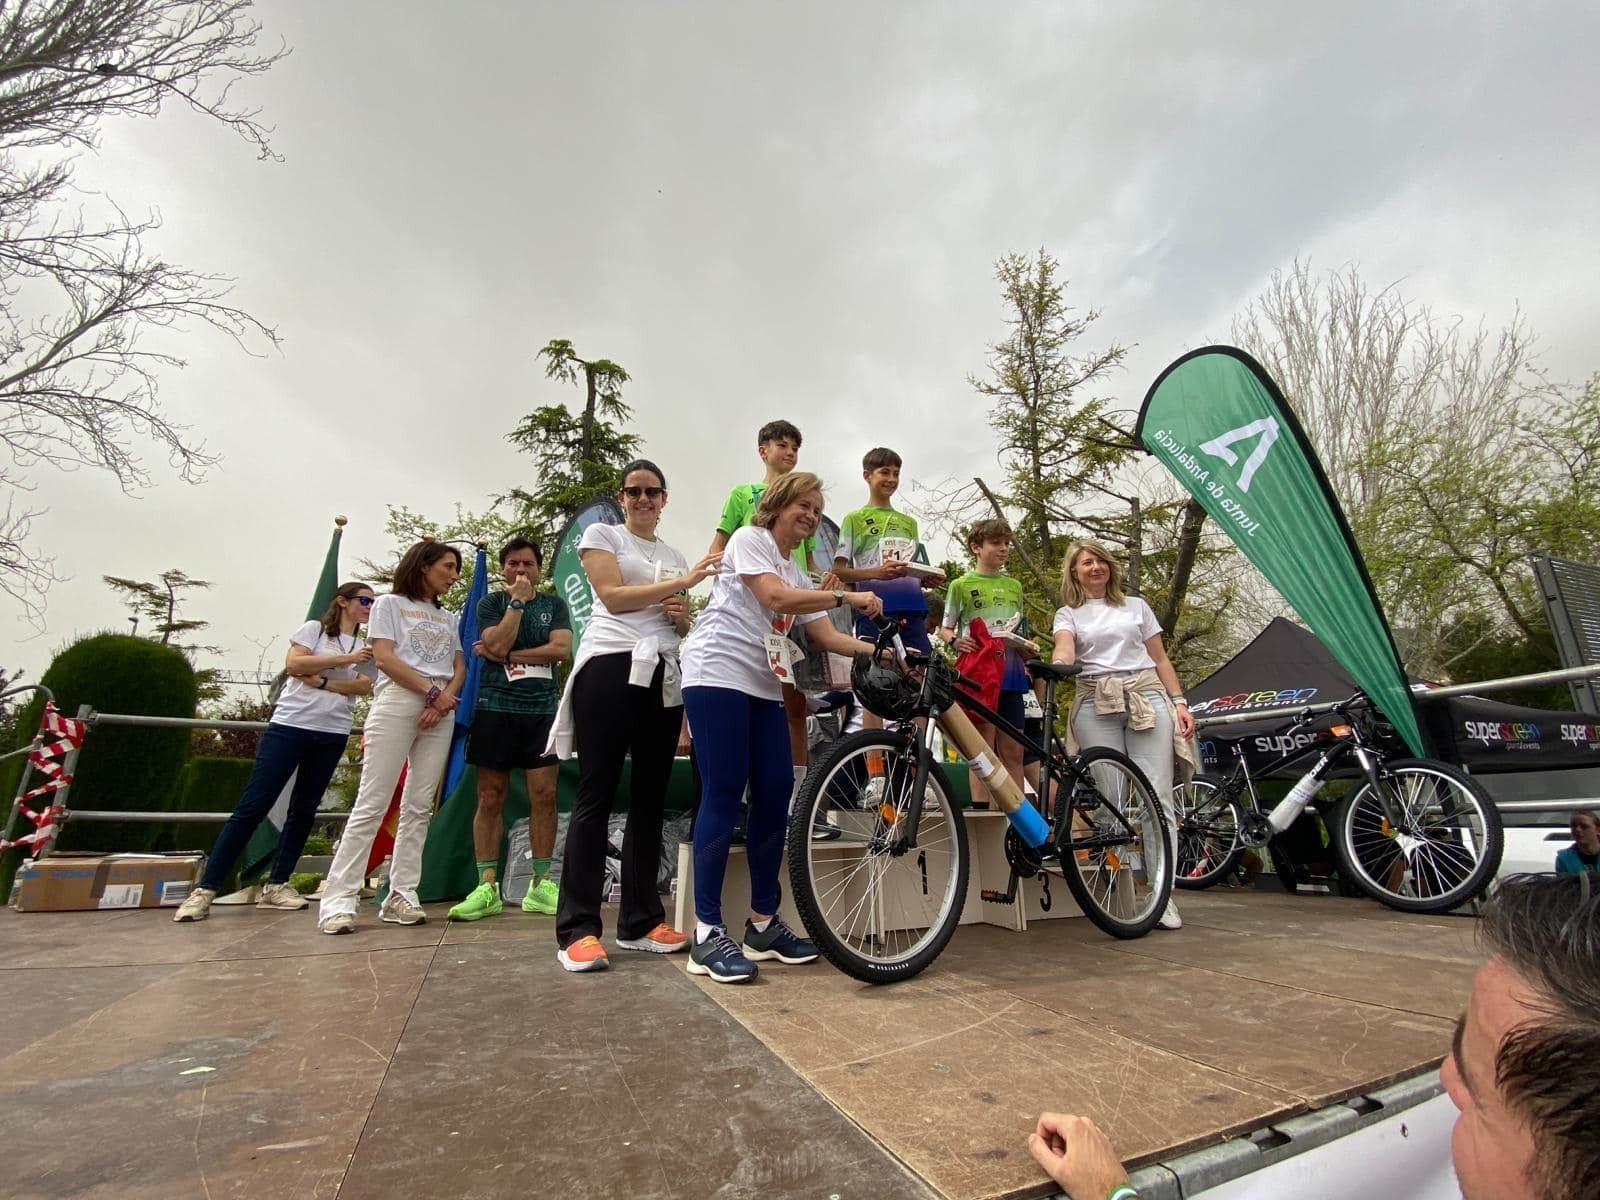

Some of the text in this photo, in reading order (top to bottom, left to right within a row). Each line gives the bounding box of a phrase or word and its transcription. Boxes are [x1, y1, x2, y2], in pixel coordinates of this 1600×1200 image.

[1188, 687, 1318, 713] erscreen
[1465, 720, 1543, 747] superscreen
[917, 850, 928, 895] 1
[1038, 871, 1052, 912] 3
